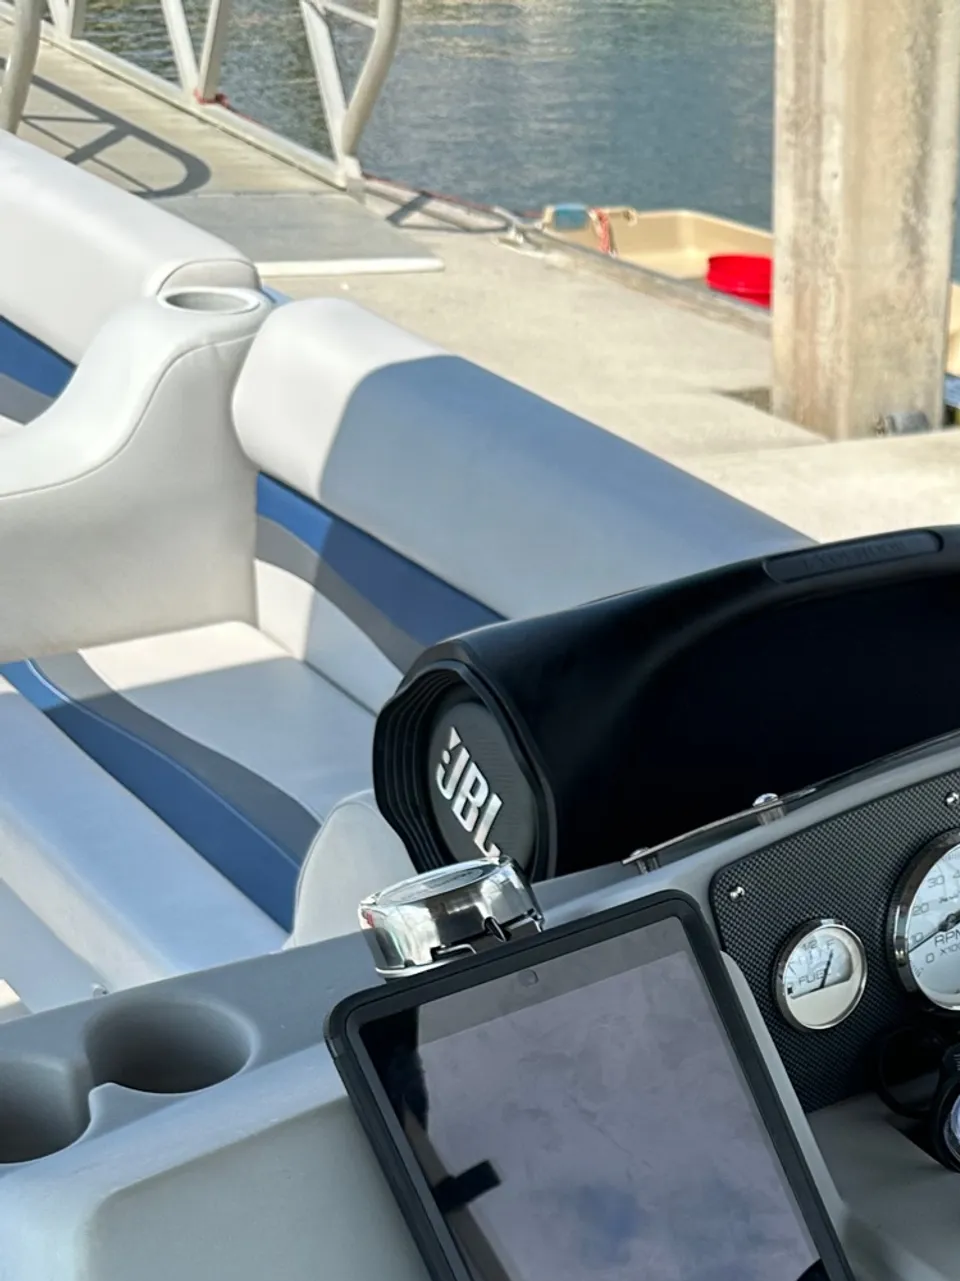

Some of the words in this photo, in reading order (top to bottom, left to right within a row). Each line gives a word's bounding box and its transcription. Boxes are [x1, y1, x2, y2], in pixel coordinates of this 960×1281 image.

[436, 730, 503, 858] JBL
[927, 874, 945, 888] 30
[913, 902, 930, 916] 20
[925, 953, 935, 964] 0
